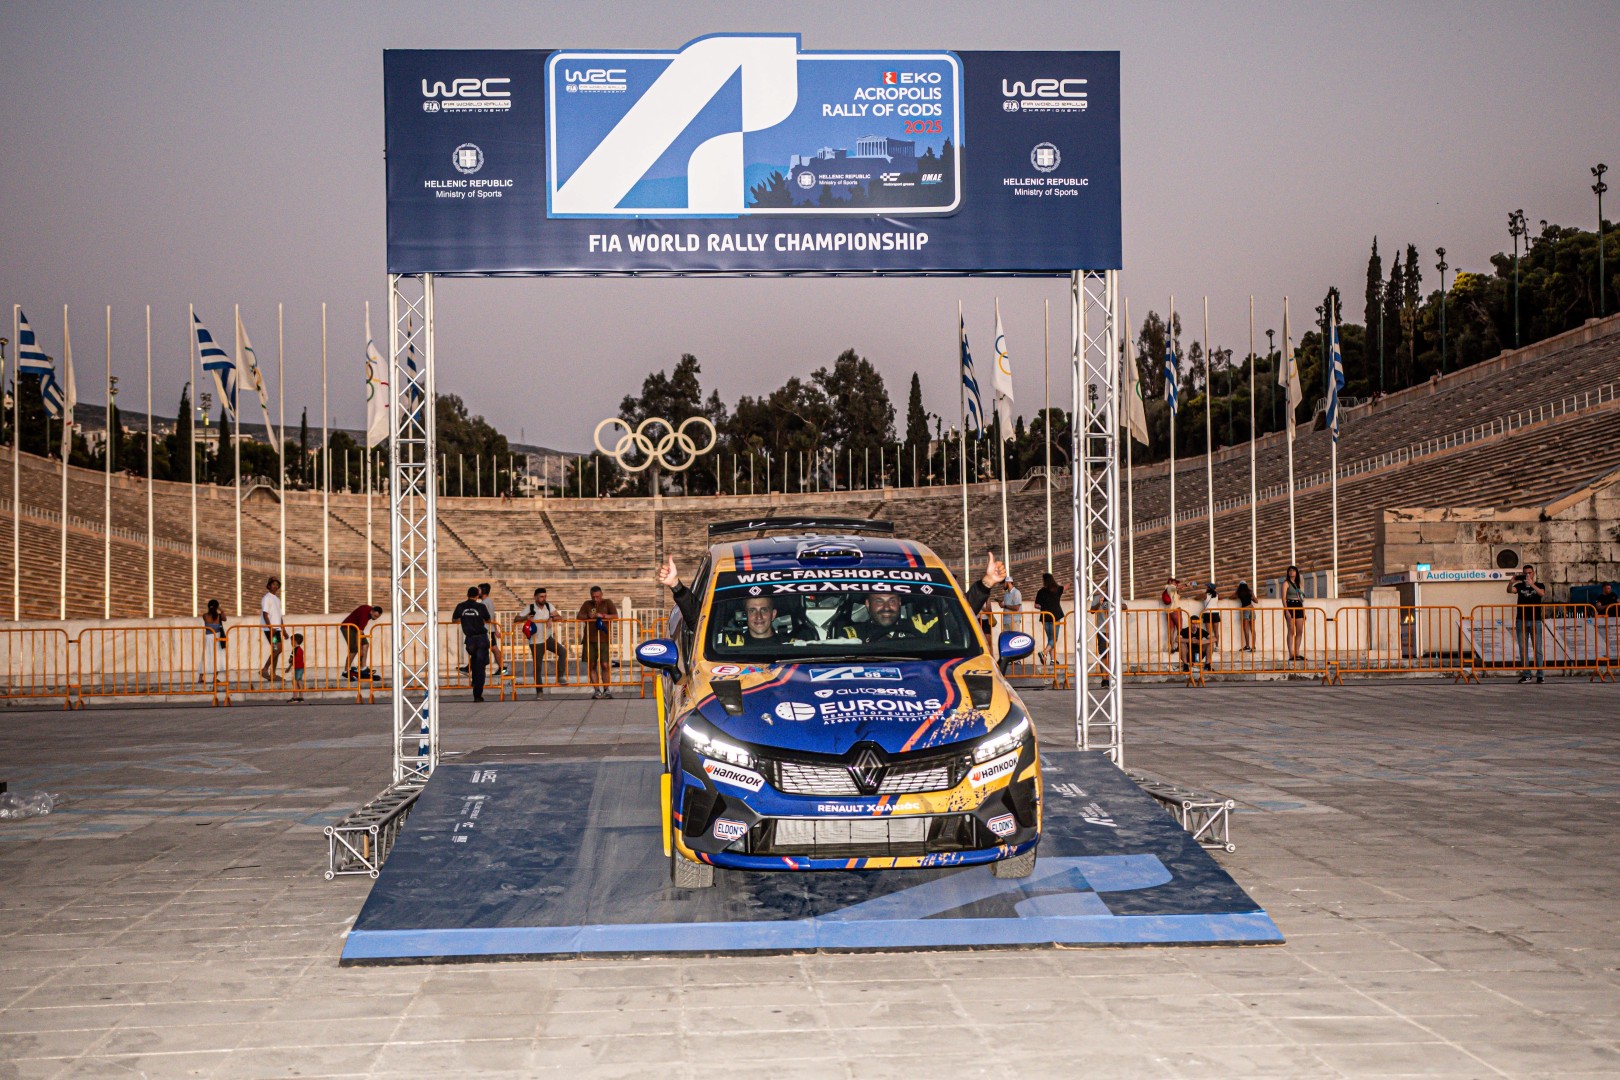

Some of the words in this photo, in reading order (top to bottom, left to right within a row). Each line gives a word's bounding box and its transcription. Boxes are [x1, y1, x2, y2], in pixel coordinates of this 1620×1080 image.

[566, 69, 626, 82] WRC
[901, 73, 942, 83] EKO
[422, 78, 511, 97] WRC
[854, 87, 942, 100] ACROPOLIS
[1003, 79, 1088, 97] WRC
[424, 102, 439, 112] FIA
[822, 104, 869, 116] RALLY
[872, 104, 894, 116] OF
[897, 104, 942, 116] GODS
[1004, 102, 1019, 110] FIA
[904, 120, 942, 134] 2025
[436, 190, 465, 199] Ministry
[477, 190, 502, 199] Sports
[1014, 188, 1043, 197] Ministry
[1054, 188, 1078, 197] Sports
[589, 234, 622, 252] FIA
[628, 234, 700, 252] WORLD
[707, 234, 768, 252] RALLY
[774, 232, 929, 251] CHAMPIONSHIP
[737, 570, 932, 583] WRC-FANSHOP.COM
[1426, 571, 1486, 581] Audioguides
[820, 699, 942, 714] EUROINS
[718, 824, 744, 835] ELDON'S
